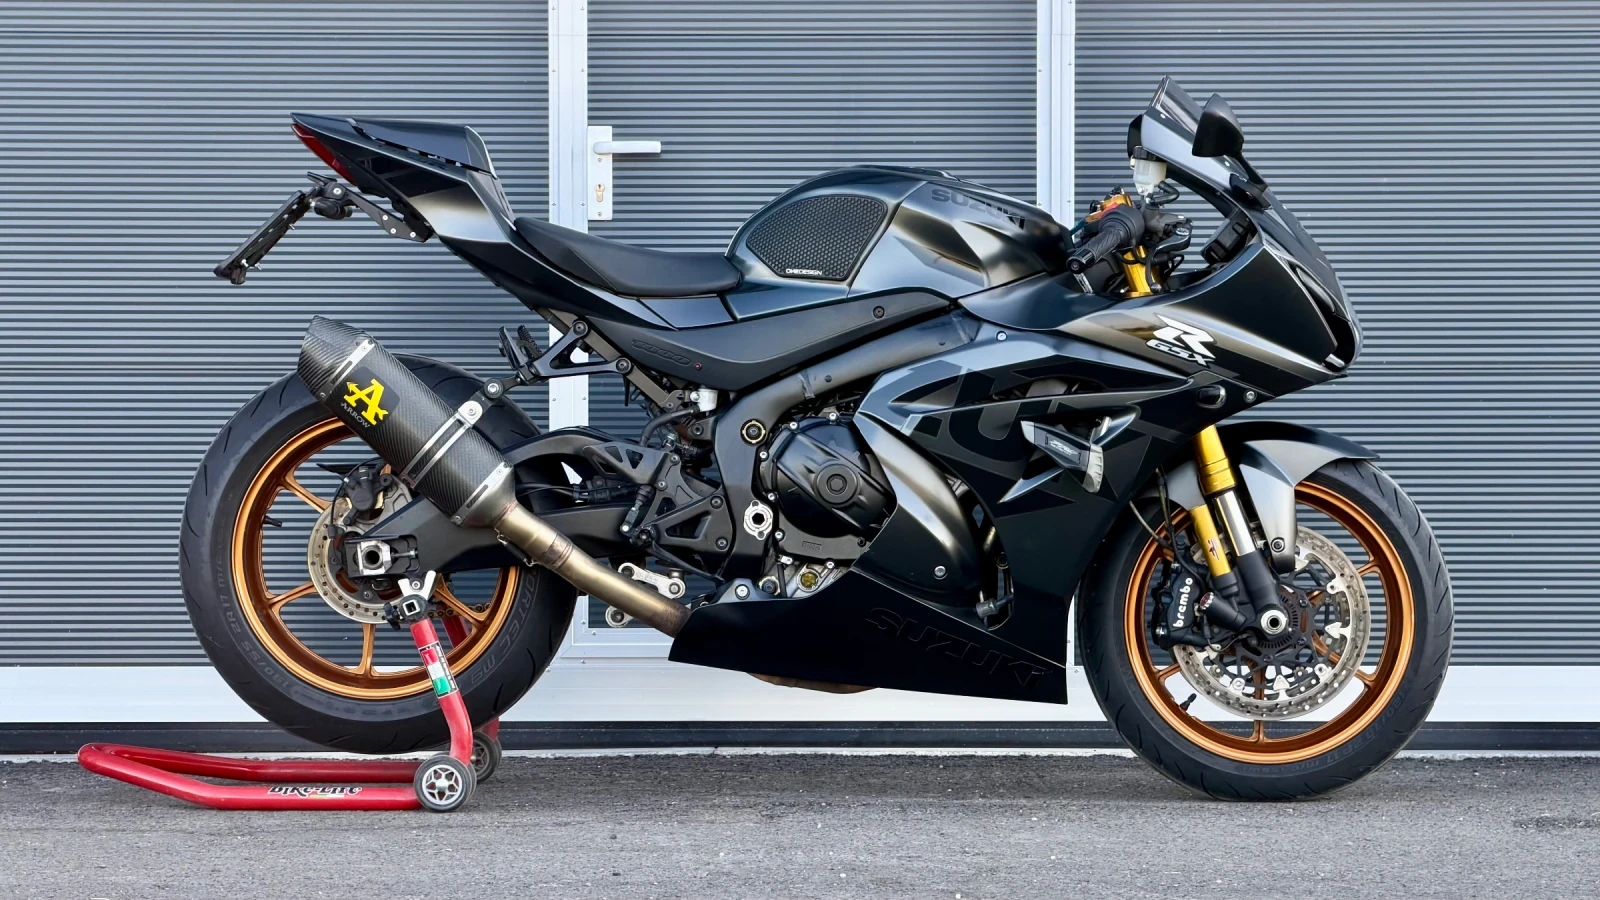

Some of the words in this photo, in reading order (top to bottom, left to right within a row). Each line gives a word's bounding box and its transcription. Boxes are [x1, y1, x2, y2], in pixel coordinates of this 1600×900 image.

[1146, 339, 1214, 366] GSX
[340, 402, 370, 428] ARROW
[1172, 577, 1193, 628] brembo
